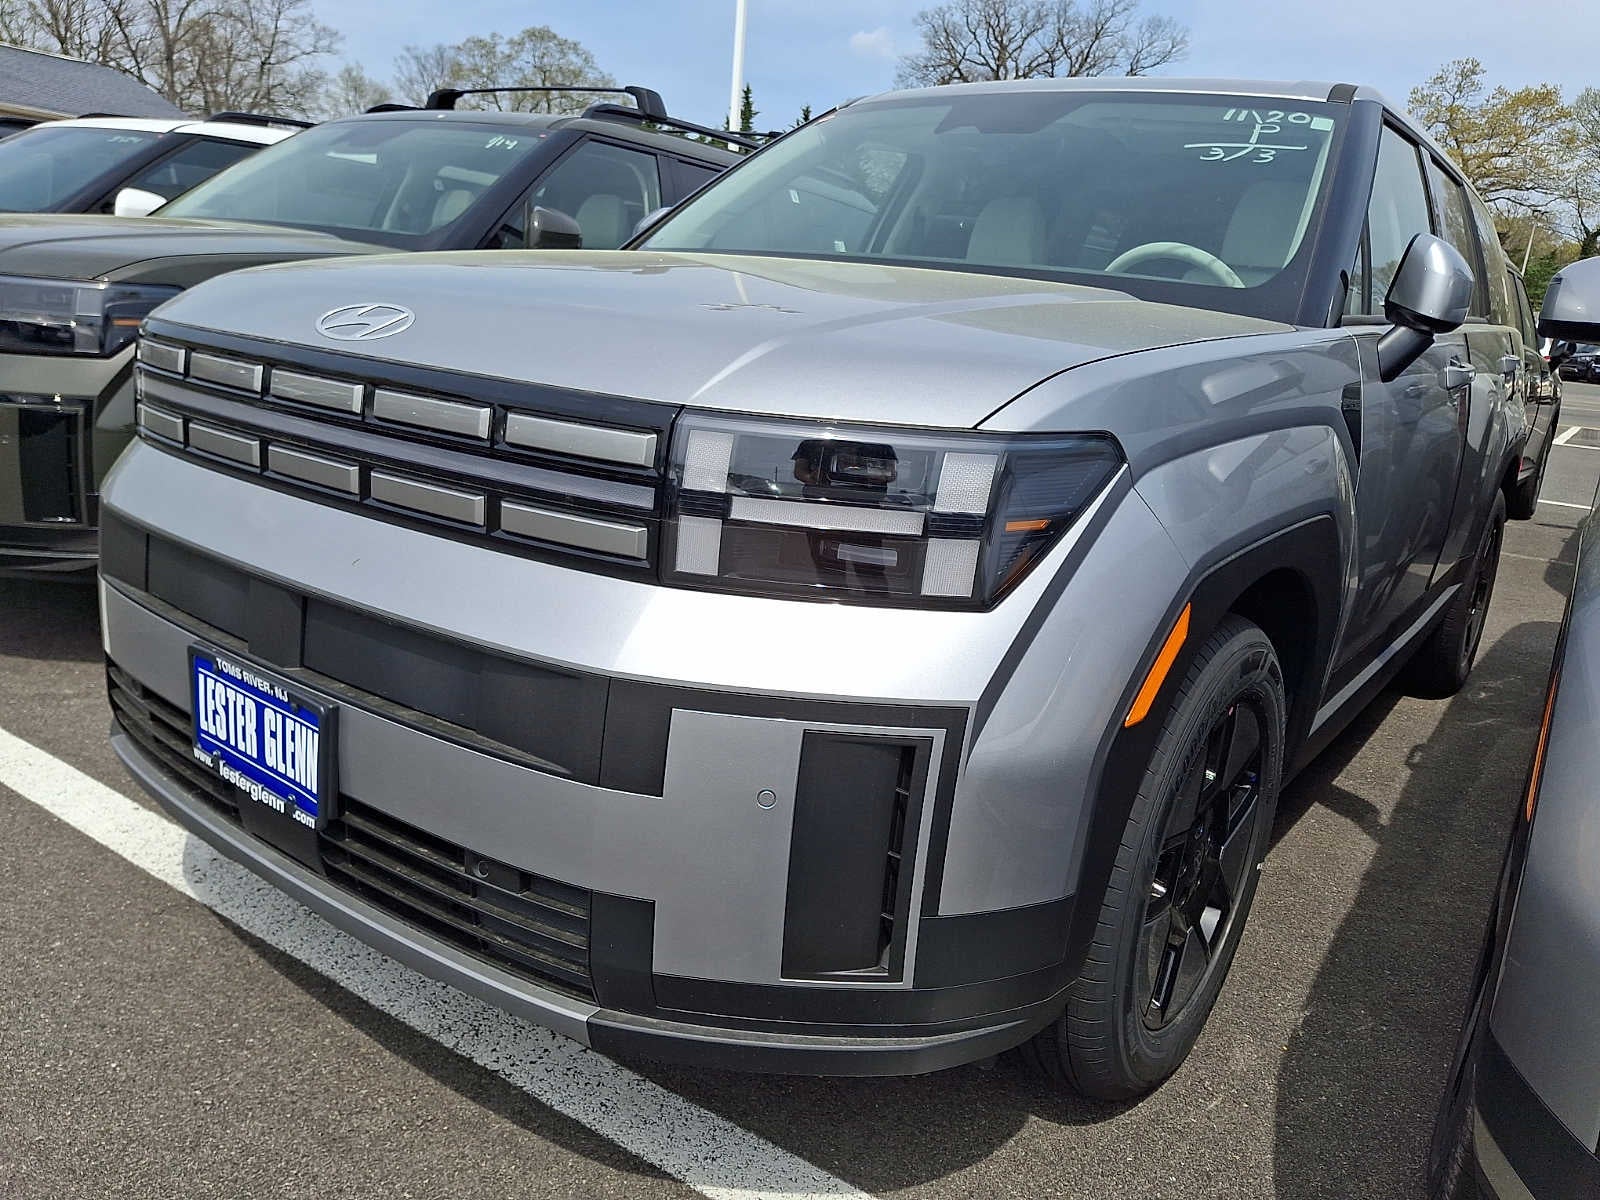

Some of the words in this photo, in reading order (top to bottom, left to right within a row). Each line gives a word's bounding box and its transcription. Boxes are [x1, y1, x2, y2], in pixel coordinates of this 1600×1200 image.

[216, 657, 242, 680] TOMS
[273, 686, 289, 703] NJ
[198, 672, 258, 759] LESTER
[263, 707, 320, 795] GLENN
